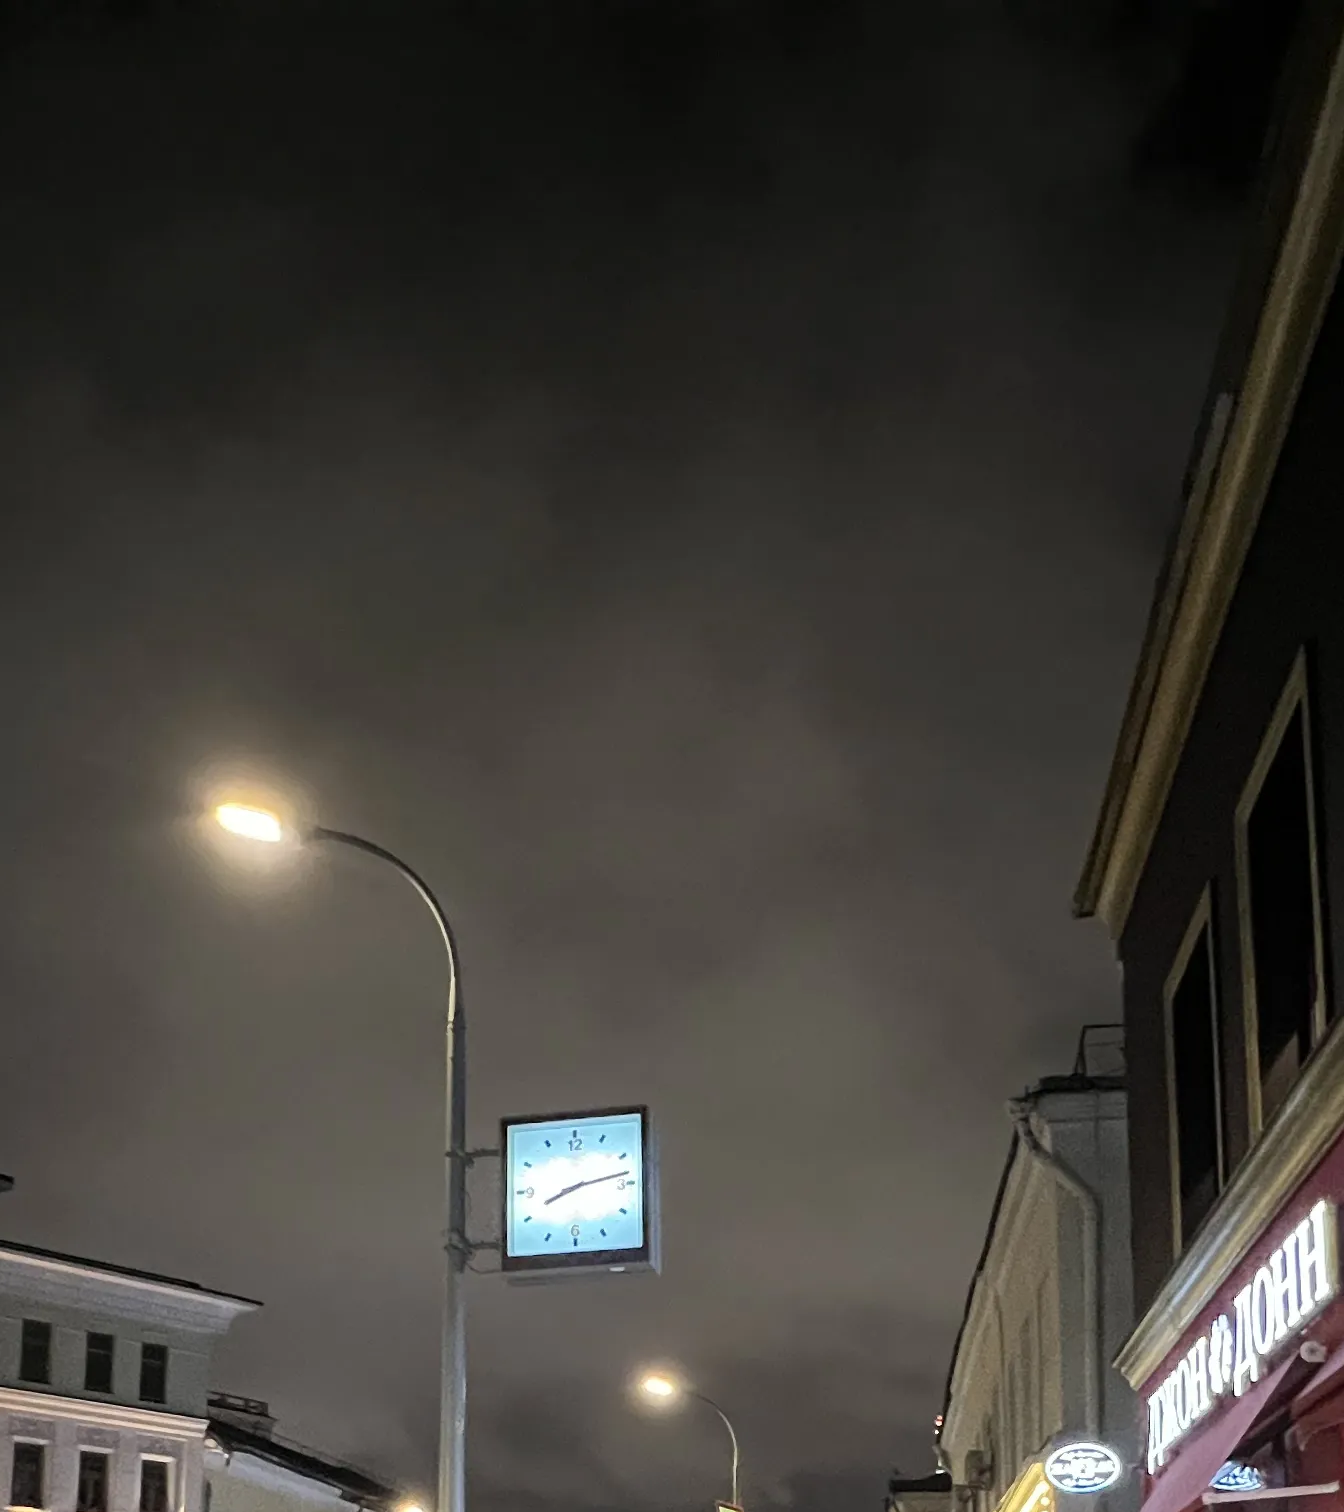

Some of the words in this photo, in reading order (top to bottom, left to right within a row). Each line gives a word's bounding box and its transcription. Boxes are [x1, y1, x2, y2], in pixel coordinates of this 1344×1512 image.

[568, 1138, 583, 1151] 12
[616, 1178, 626, 1190] 3
[525, 1186, 535, 1199] 9
[570, 1224, 580, 1237] 6
[1148, 1337, 1211, 1475] ДЖОН
[1233, 1199, 1330, 1397] ДОНН
